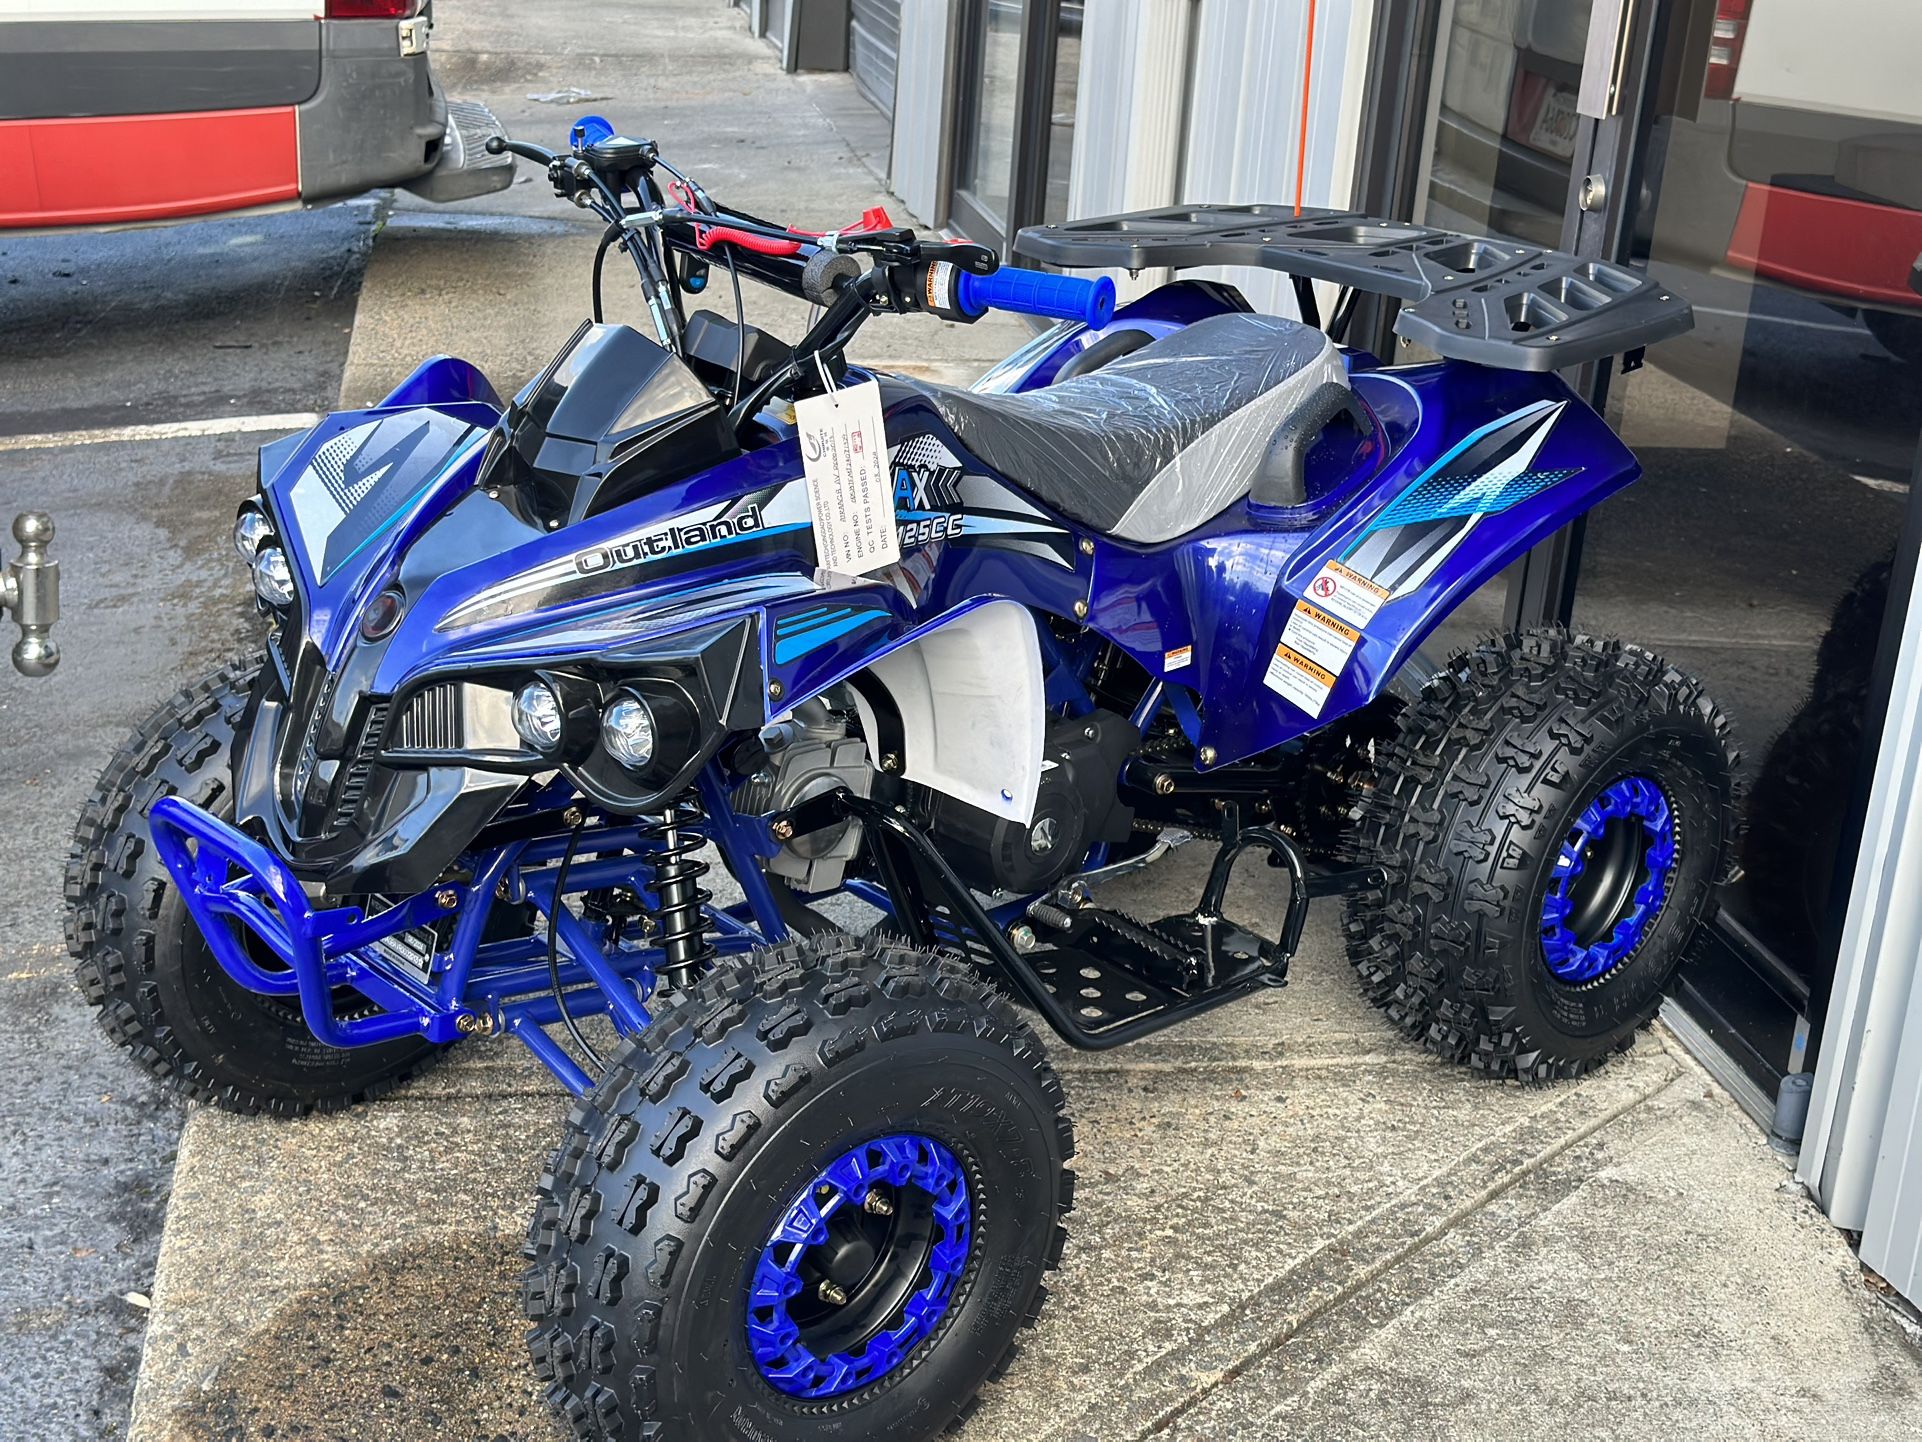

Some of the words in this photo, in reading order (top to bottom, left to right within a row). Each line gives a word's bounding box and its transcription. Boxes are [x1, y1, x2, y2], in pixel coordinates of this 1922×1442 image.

[812, 478, 820, 502] SCIENCE
[860, 466, 869, 505] PASSED:
[864, 506, 873, 536] TESTS
[896, 514, 963, 548] 125CC
[574, 504, 763, 575] Outland
[827, 521, 835, 556] TECHNOLOGY
[854, 528, 864, 558] ENGINE
[869, 539, 875, 554] QC
[1345, 571, 1380, 594] WARNING
[1314, 611, 1350, 636] WARNING
[1293, 656, 1326, 681] WARNING
